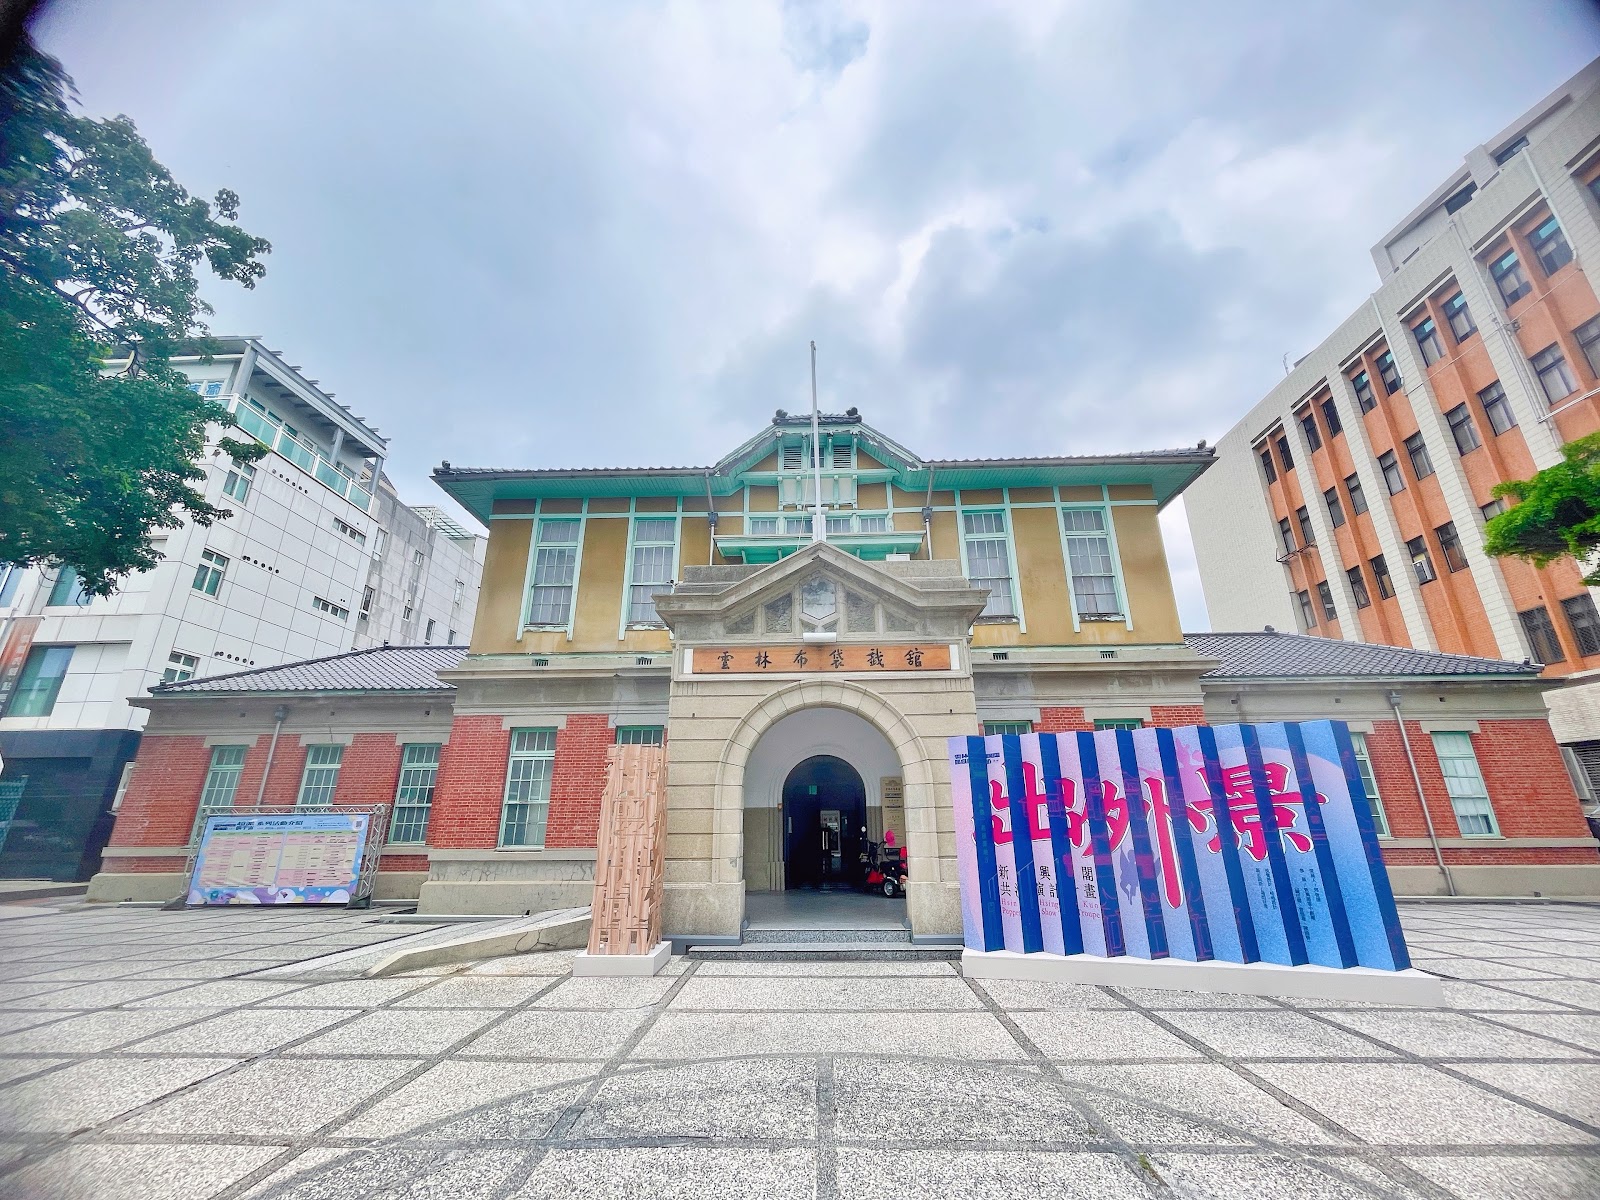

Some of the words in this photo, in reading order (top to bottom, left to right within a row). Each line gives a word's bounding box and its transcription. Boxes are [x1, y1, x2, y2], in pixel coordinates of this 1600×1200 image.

[972, 761, 1329, 909] 出外景
[1039, 898, 1059, 909] Hsing
